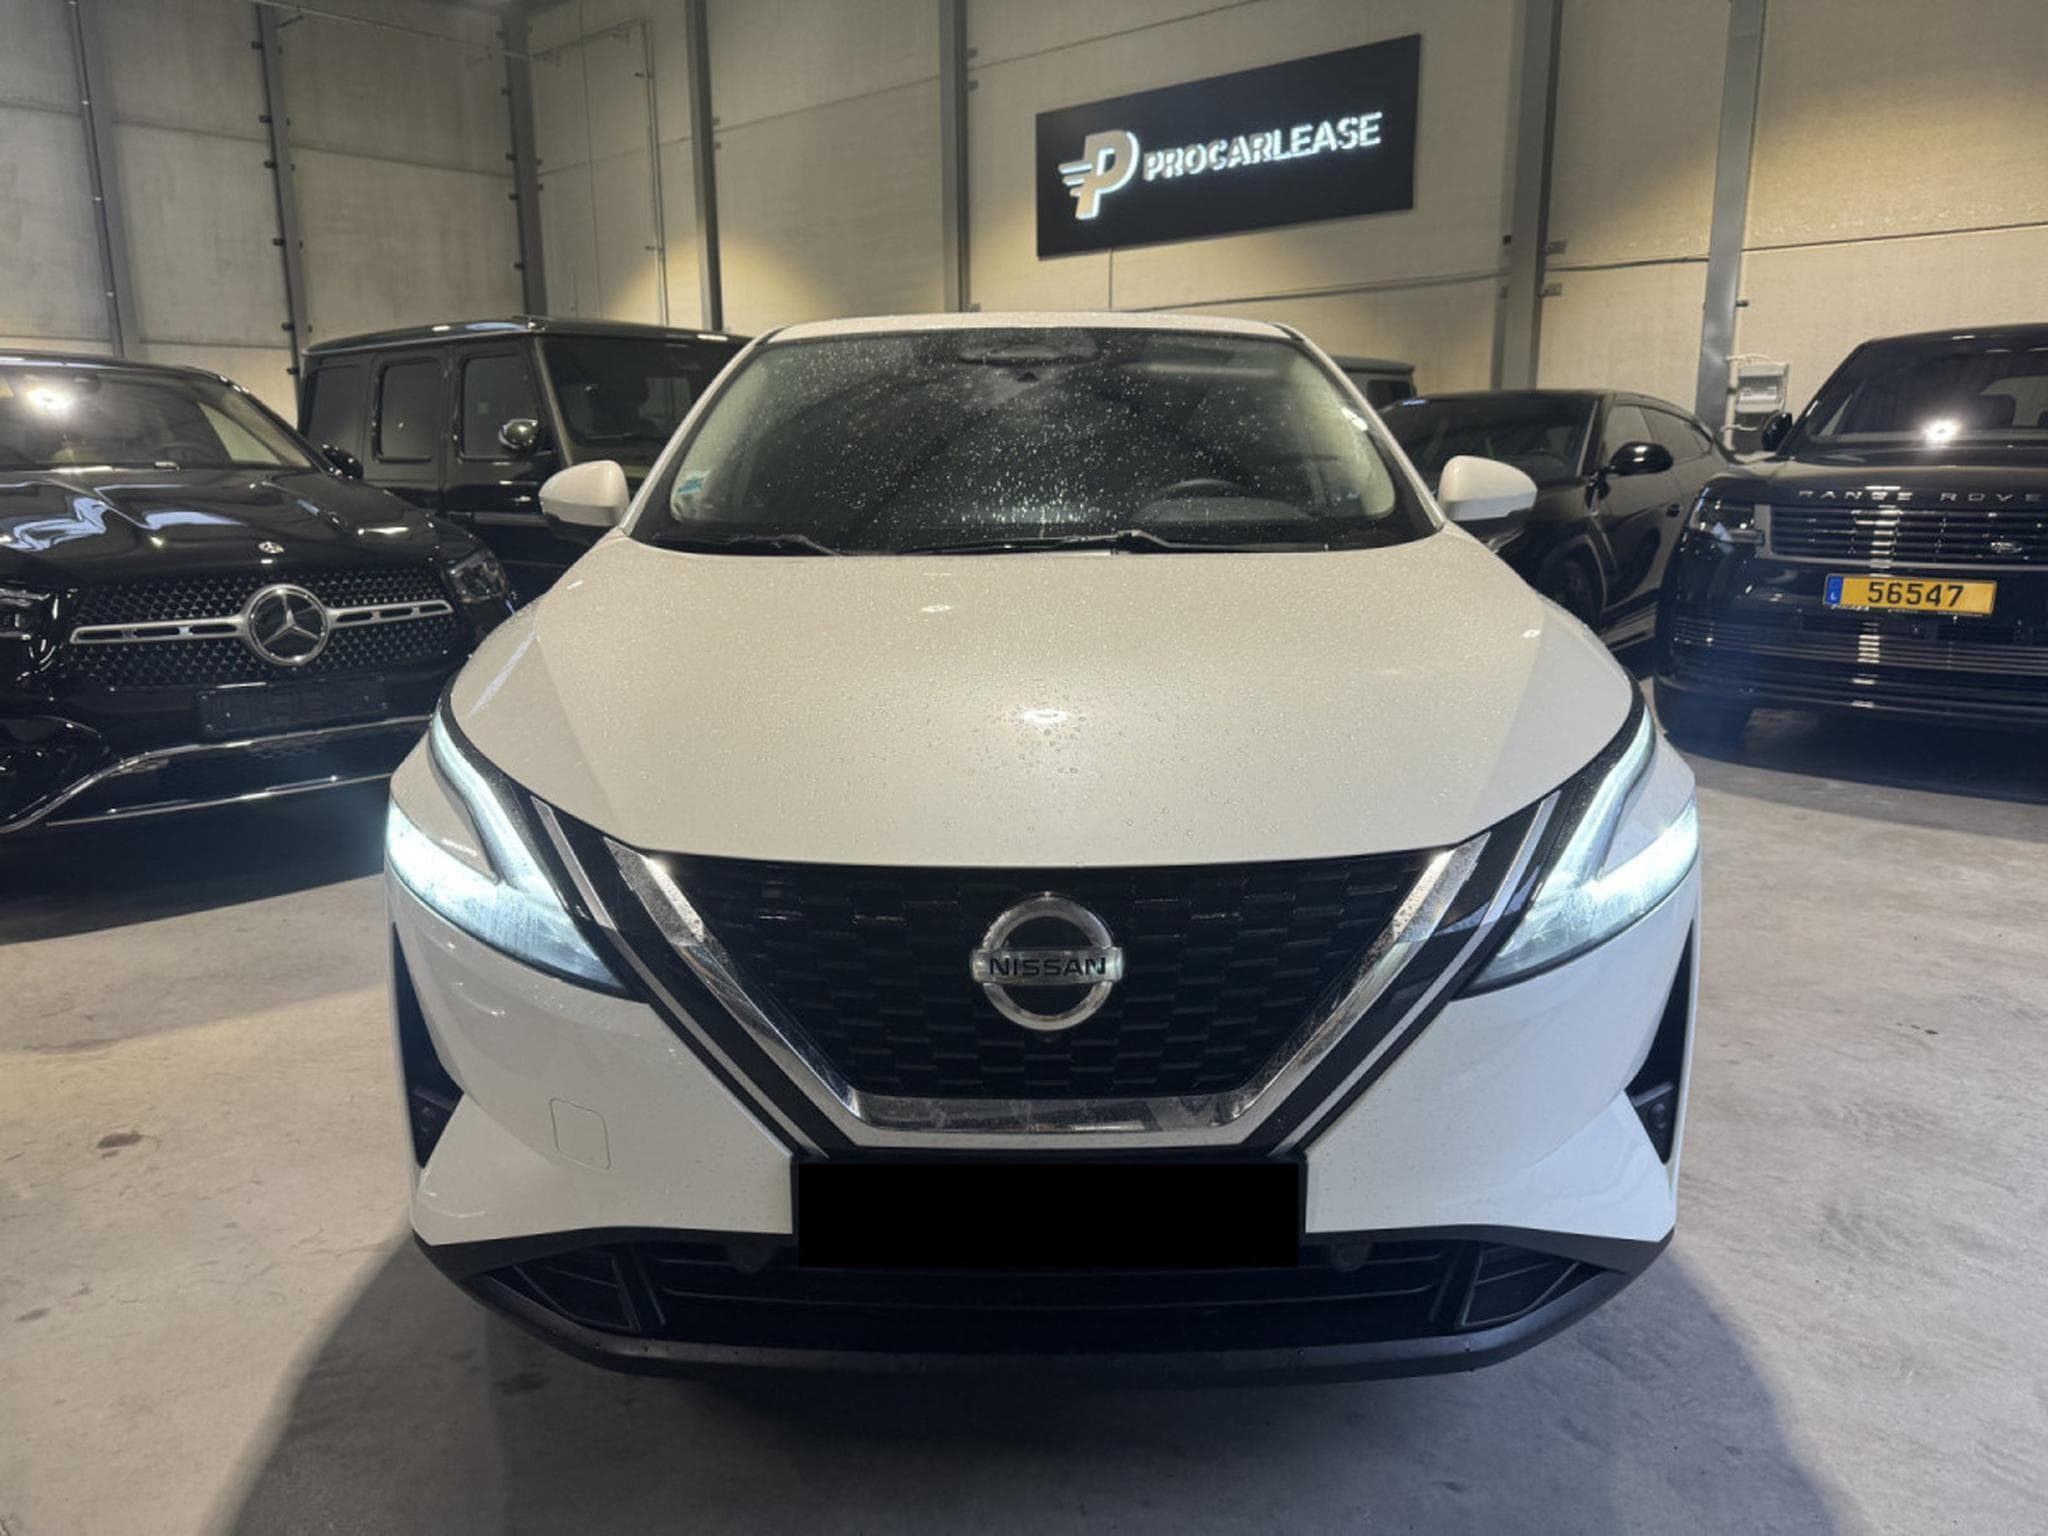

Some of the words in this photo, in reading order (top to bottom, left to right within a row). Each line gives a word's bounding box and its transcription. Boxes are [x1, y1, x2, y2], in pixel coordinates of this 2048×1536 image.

[1143, 111, 1383, 182] PROCARLEASE
[1798, 489, 1913, 501] RANGE
[1867, 581, 1965, 608] 56547
[989, 957, 1107, 976] NISSAN
